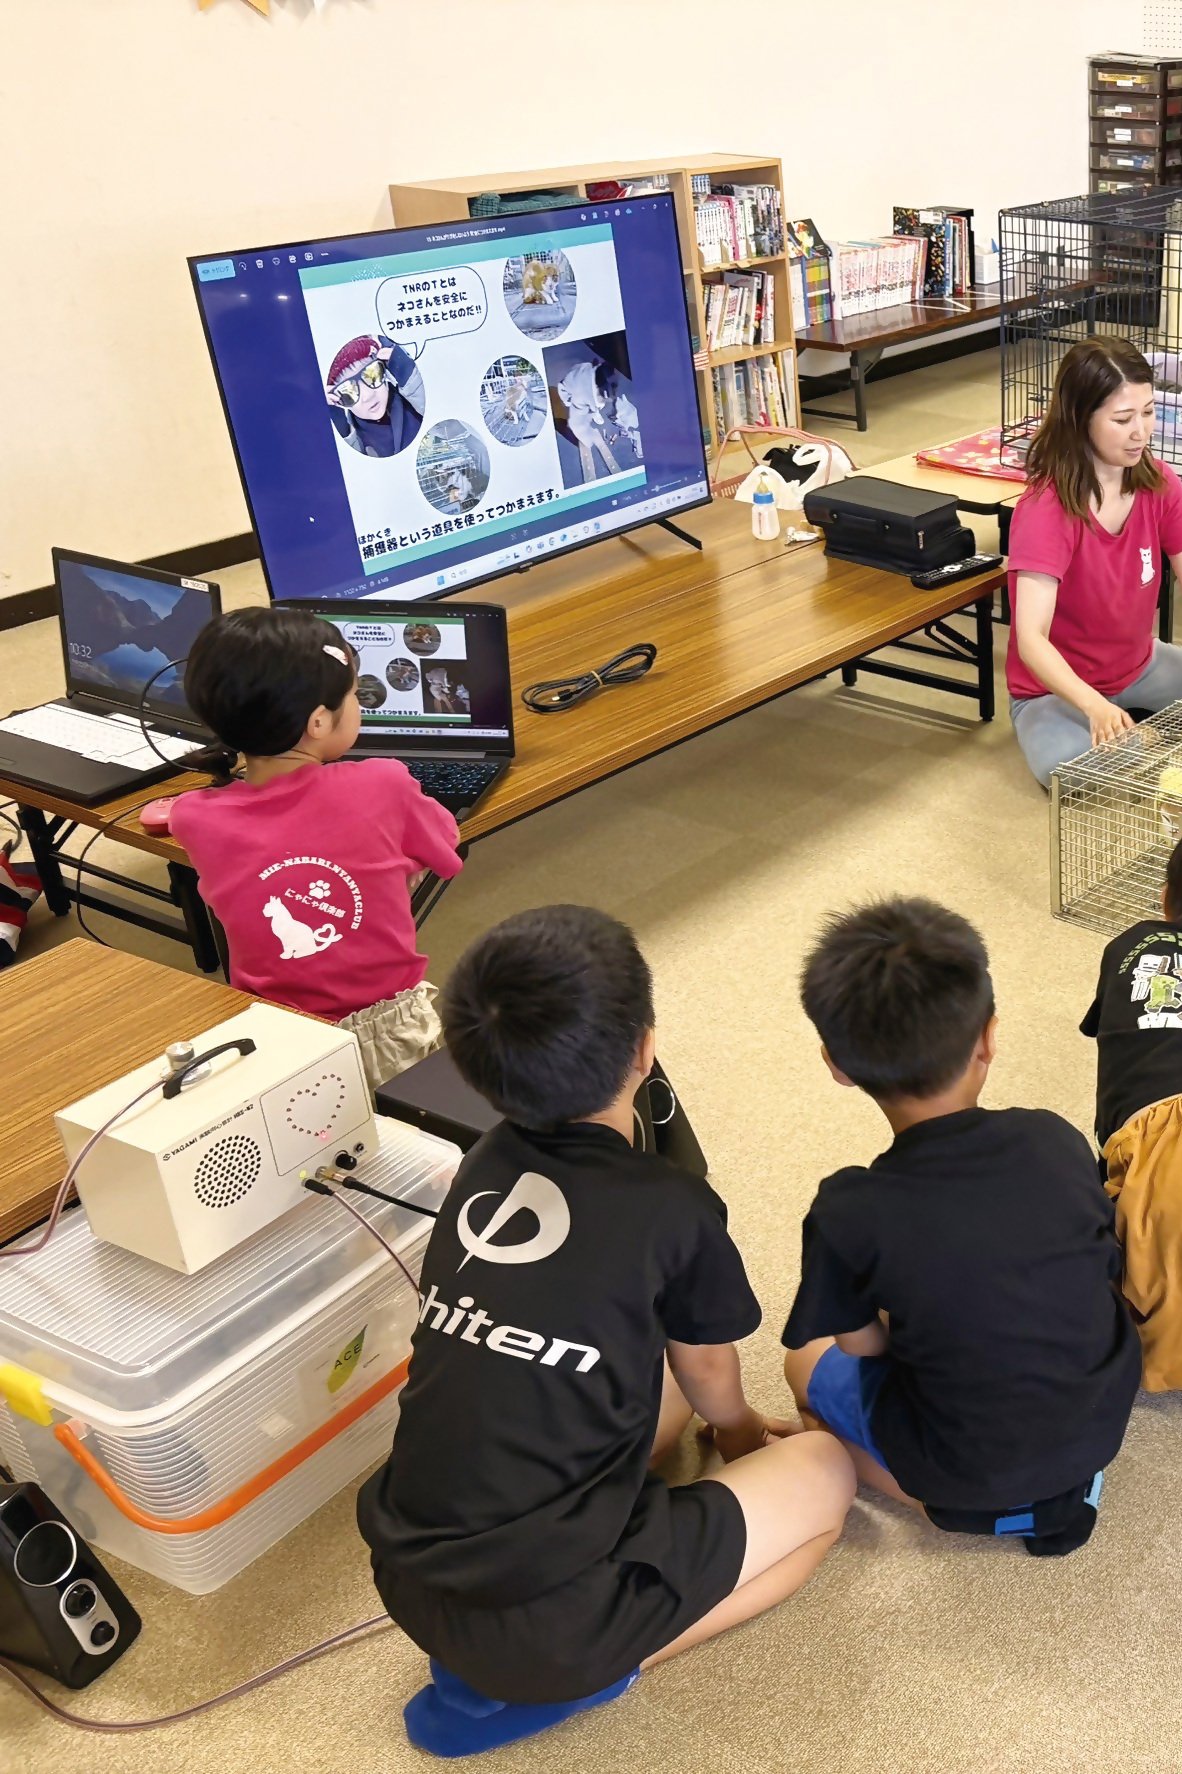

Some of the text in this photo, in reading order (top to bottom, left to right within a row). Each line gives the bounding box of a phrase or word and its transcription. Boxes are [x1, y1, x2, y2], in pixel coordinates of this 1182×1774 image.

[402, 276, 457, 294] TNRのTとは
[396, 291, 468, 312] ネコさんを安全に
[361, 488, 561, 560] 捕獲器という道具を使ってつかまえます。
[357, 527, 392, 545] ほかくき
[170, 1137, 198, 1157] YAGAMI
[419, 1284, 601, 1373] hiten
[334, 1343, 362, 1370] ACE
